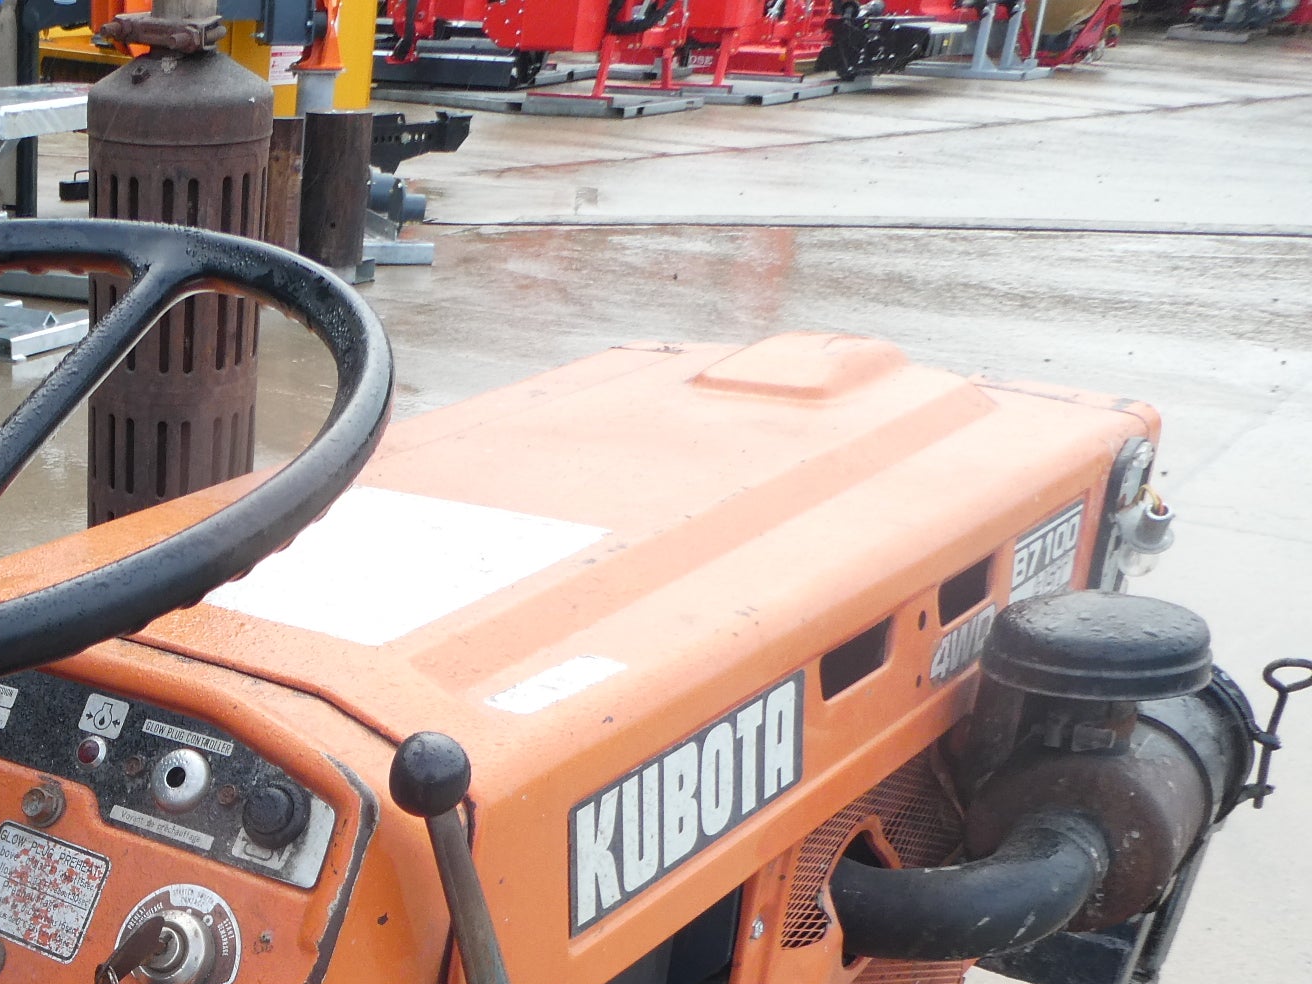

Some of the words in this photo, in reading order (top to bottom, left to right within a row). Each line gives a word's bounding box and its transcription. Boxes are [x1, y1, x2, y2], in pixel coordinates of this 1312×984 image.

[1012, 514, 1081, 589] B7100
[929, 603, 996, 679] 4WD
[145, 721, 165, 734] GLOW
[166, 727, 185, 741] PLUG
[186, 732, 232, 755] CONTROLLER
[576, 680, 796, 927] KUBOTA
[0, 829, 26, 847] GLOW
[31, 841, 55, 859] PLUG
[59, 852, 103, 876] PREHEAT
[128, 905, 147, 930] PREHEAT
[222, 918, 235, 939] START
